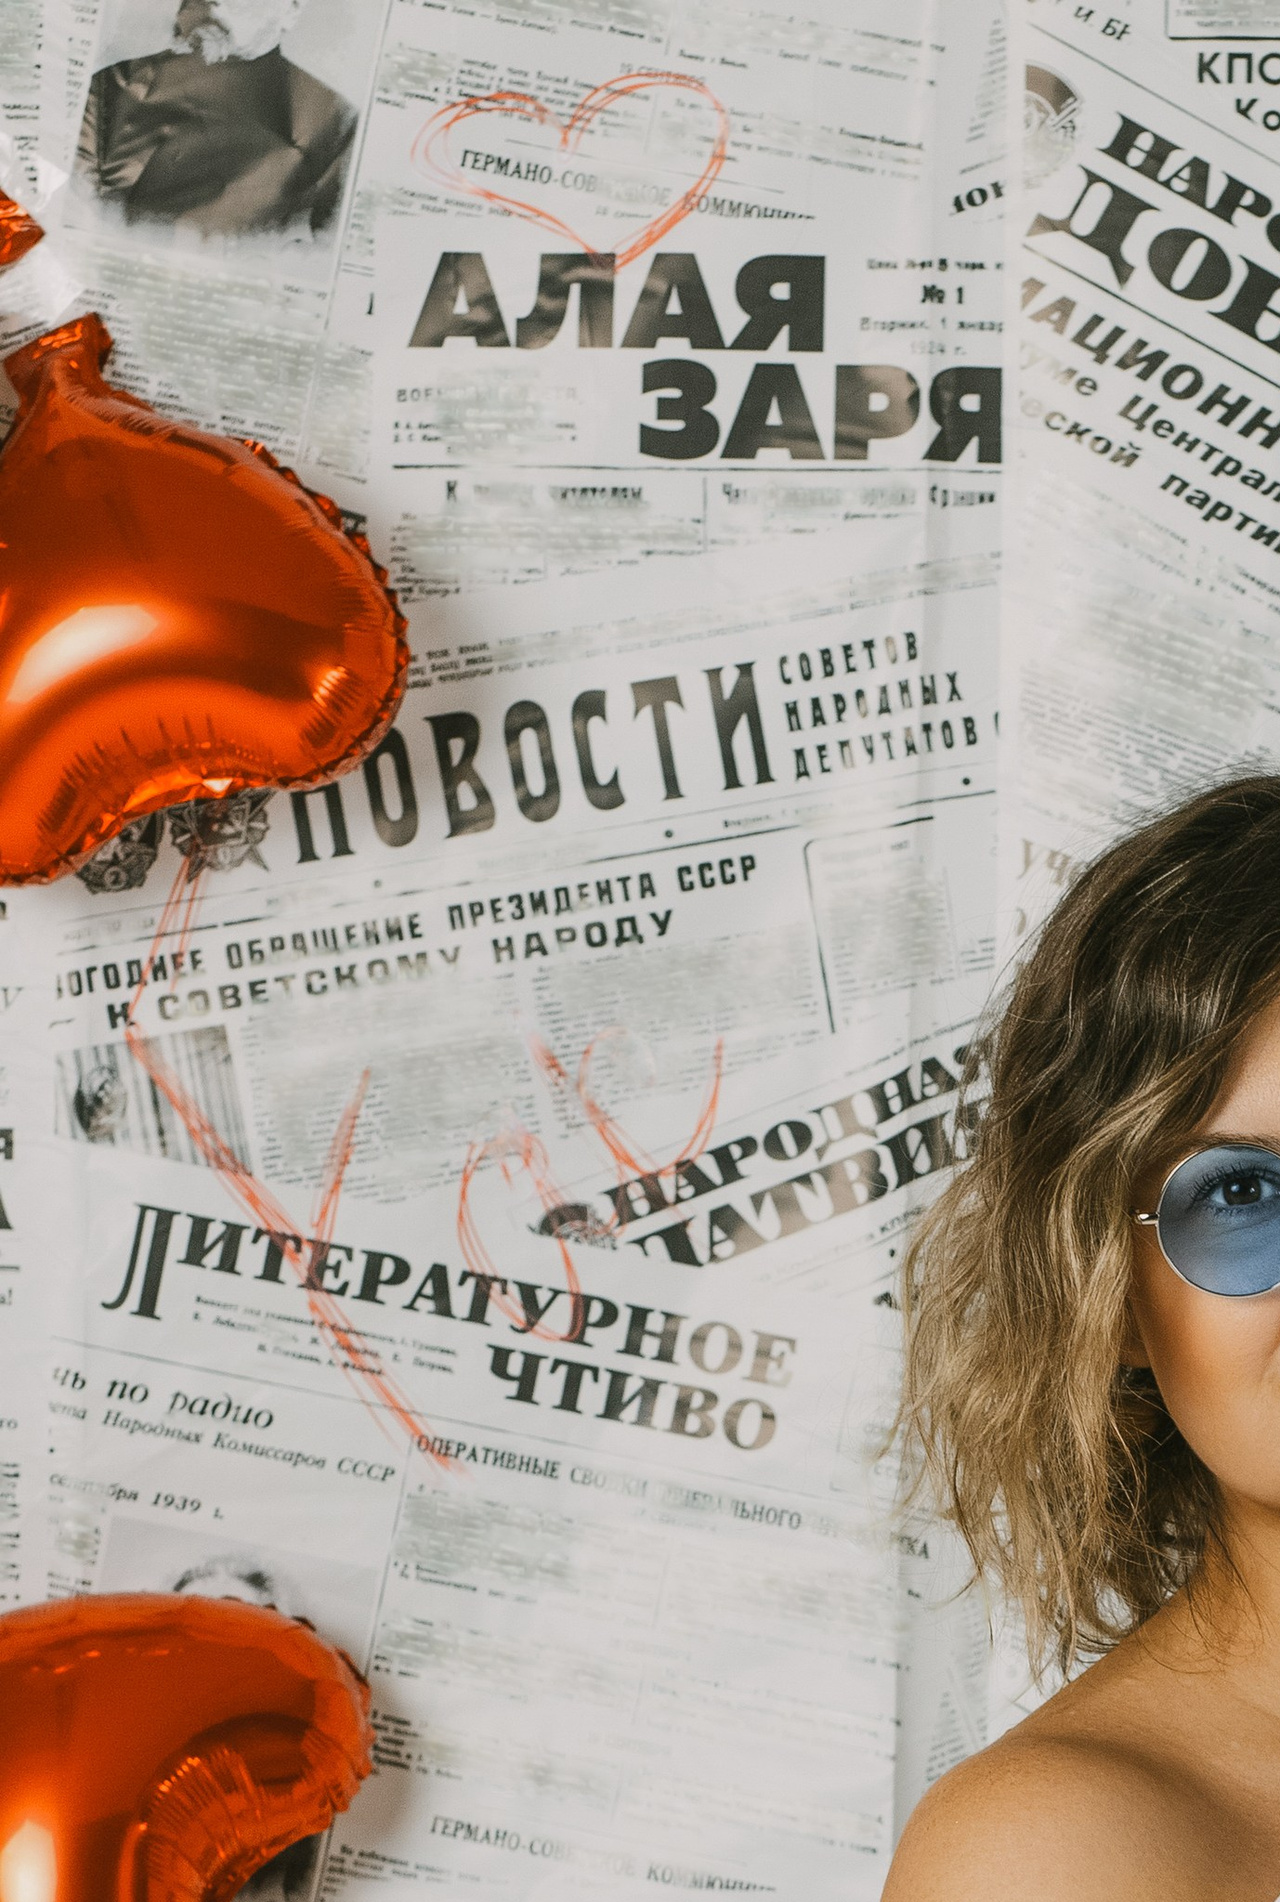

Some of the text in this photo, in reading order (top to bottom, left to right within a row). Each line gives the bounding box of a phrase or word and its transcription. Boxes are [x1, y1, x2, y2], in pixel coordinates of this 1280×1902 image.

[406, 251, 827, 352] АЛАЯ
[638, 357, 1005, 464] ЗАРЯ
[778, 631, 919, 685] СОВЕТОВ
[783, 670, 967, 732] НАРОДНЫХ
[290, 660, 776, 864] НОВОСТИ
[791, 714, 979, 781] ДЕПУТАТОВ
[226, 912, 424, 970] ОБРАЩЕНИЕ
[448, 869, 657, 930] ПРЕЗИДЕНТА
[677, 854, 758, 894] СССР
[107, 908, 675, 1029] К СОВЕТСКОМУ НАРОДУ
[100, 1202, 797, 1390] ЛИТЕРАТУРНОЕ
[106, 1374, 274, 1432] по радио
[485, 1343, 779, 1451] ЧТИВО
[102, 1407, 397, 1483] Народных Комиссаров СССР
[415, 1434, 561, 1482] ОПЕРАТИВНЫЕ
[152, 1492, 202, 1514] 1939
